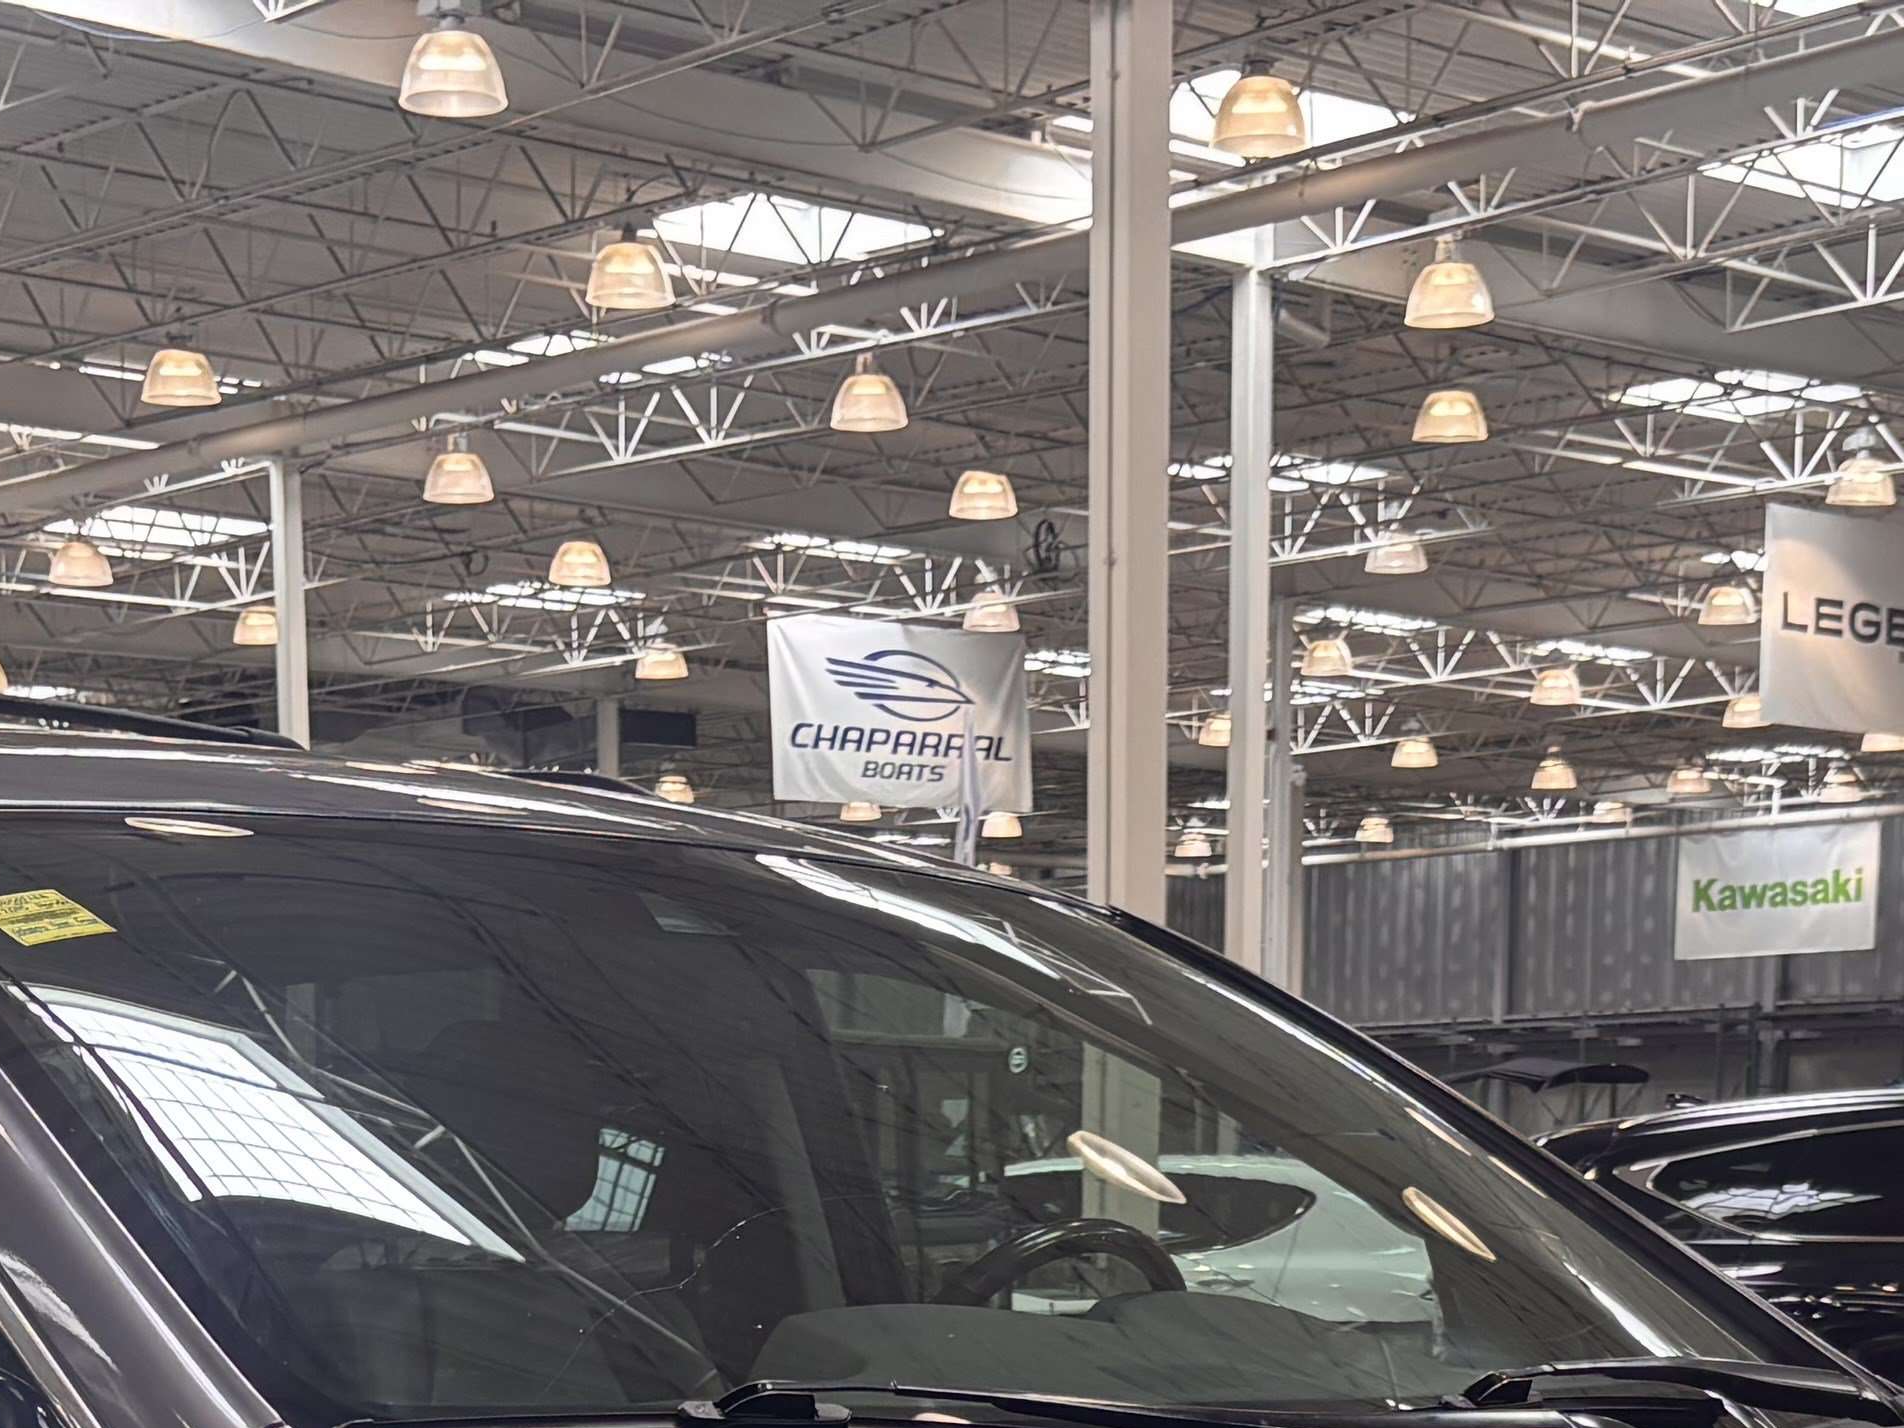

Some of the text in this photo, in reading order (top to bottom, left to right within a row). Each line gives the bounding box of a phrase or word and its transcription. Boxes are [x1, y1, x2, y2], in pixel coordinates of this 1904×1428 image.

[790, 722, 1013, 762] CHAPARRAL
[861, 761, 945, 783] BOATS
[1691, 867, 1865, 913] Kawasaki
